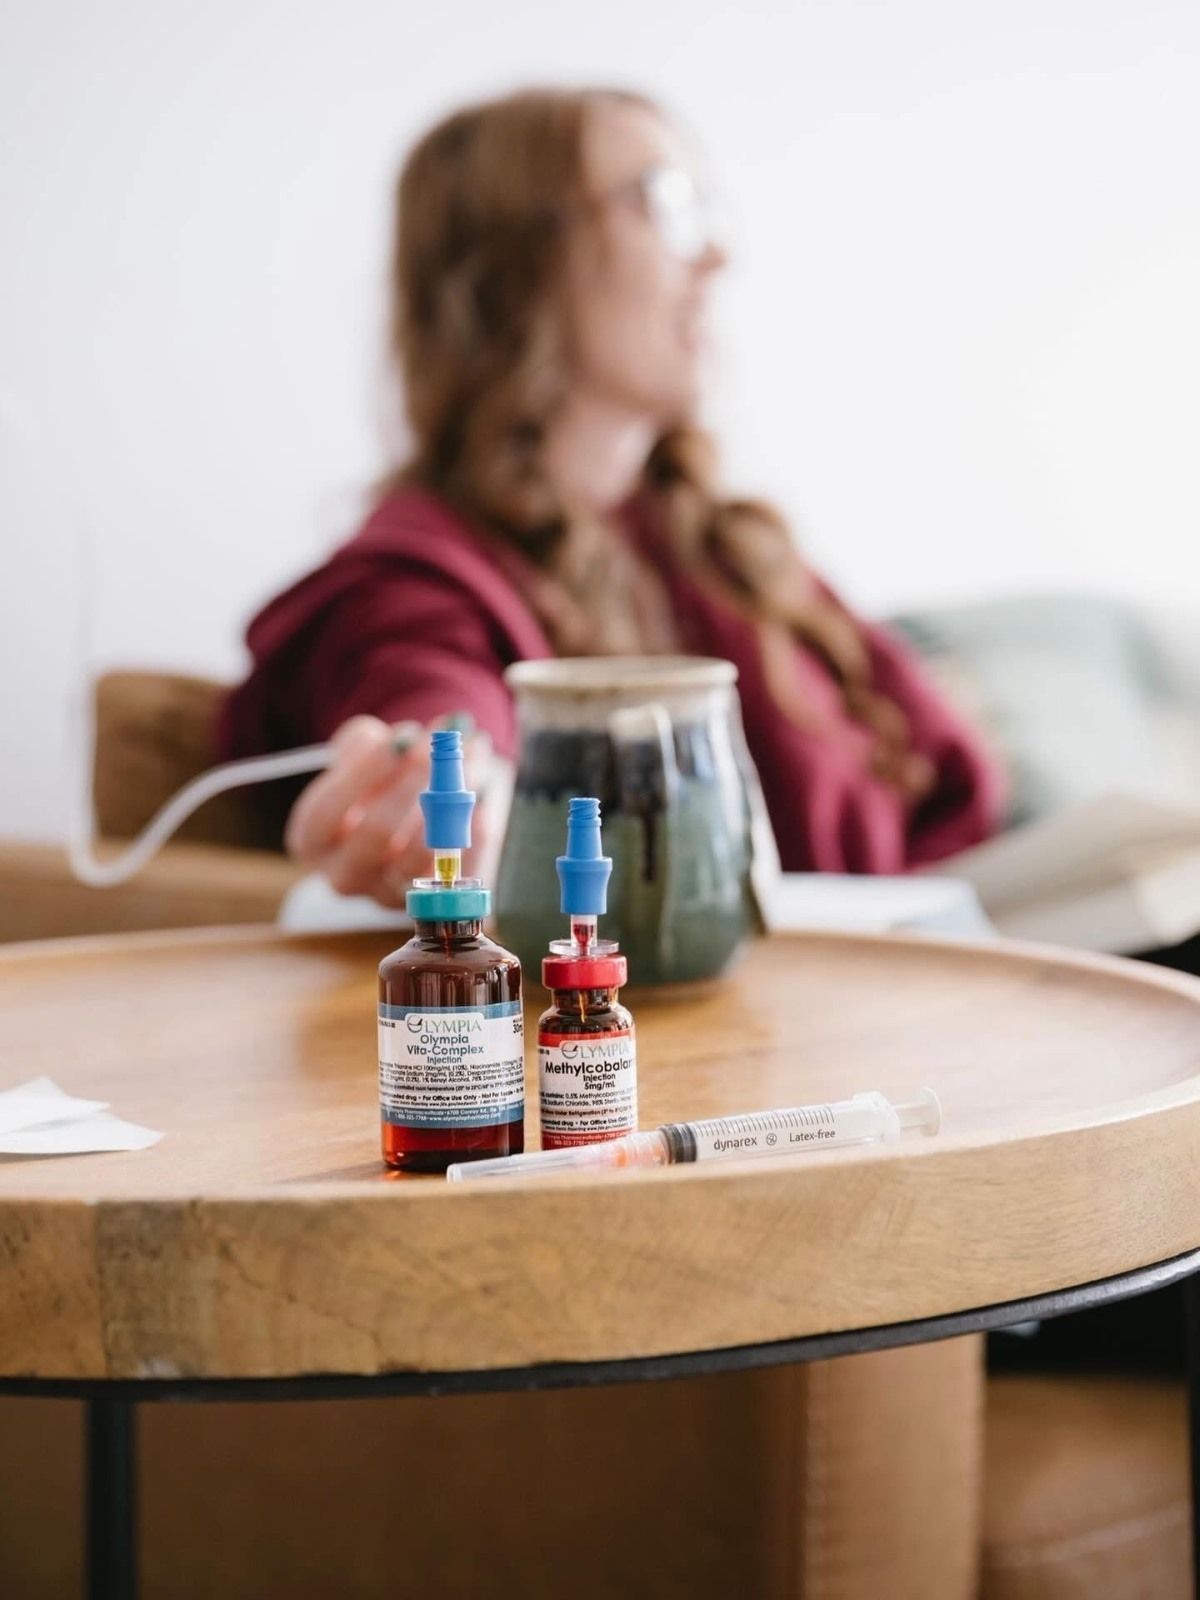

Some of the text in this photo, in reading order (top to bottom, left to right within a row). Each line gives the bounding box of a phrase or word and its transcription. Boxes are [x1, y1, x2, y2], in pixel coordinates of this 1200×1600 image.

[420, 1034, 469, 1045] Olympia
[406, 1045, 485, 1056] Vita-Complex
[427, 1056, 462, 1065] Injection
[583, 1073, 616, 1083] Injection
[713, 1129, 836, 1152] dynarex Latex-free
